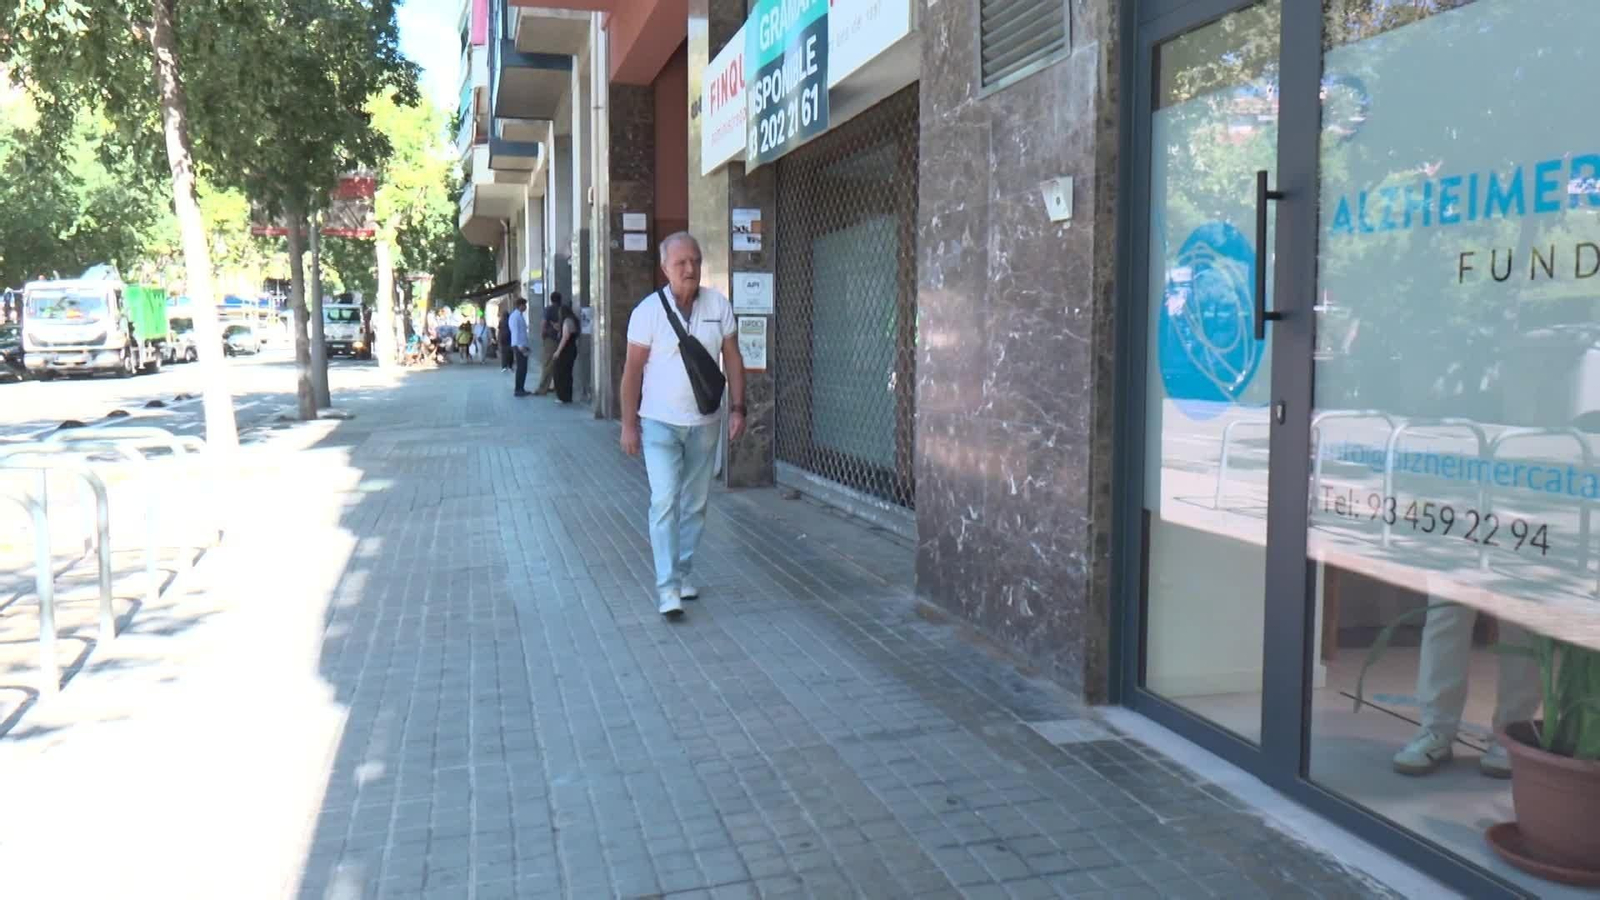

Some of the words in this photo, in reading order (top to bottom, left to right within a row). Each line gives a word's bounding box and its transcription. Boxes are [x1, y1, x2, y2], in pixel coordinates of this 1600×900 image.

[760, 108, 785, 153] 202
[788, 96, 798, 139] 21
[802, 83, 818, 127] 61
[1331, 154, 1600, 235] ALZHEIMER
[1459, 241, 1600, 284] FUND
[1320, 485, 1359, 519] Tel:
[1367, 492, 1397, 526] 93
[1403, 500, 1455, 536] 459
[1464, 509, 1500, 547] 22
[1511, 518, 1550, 556] 94
